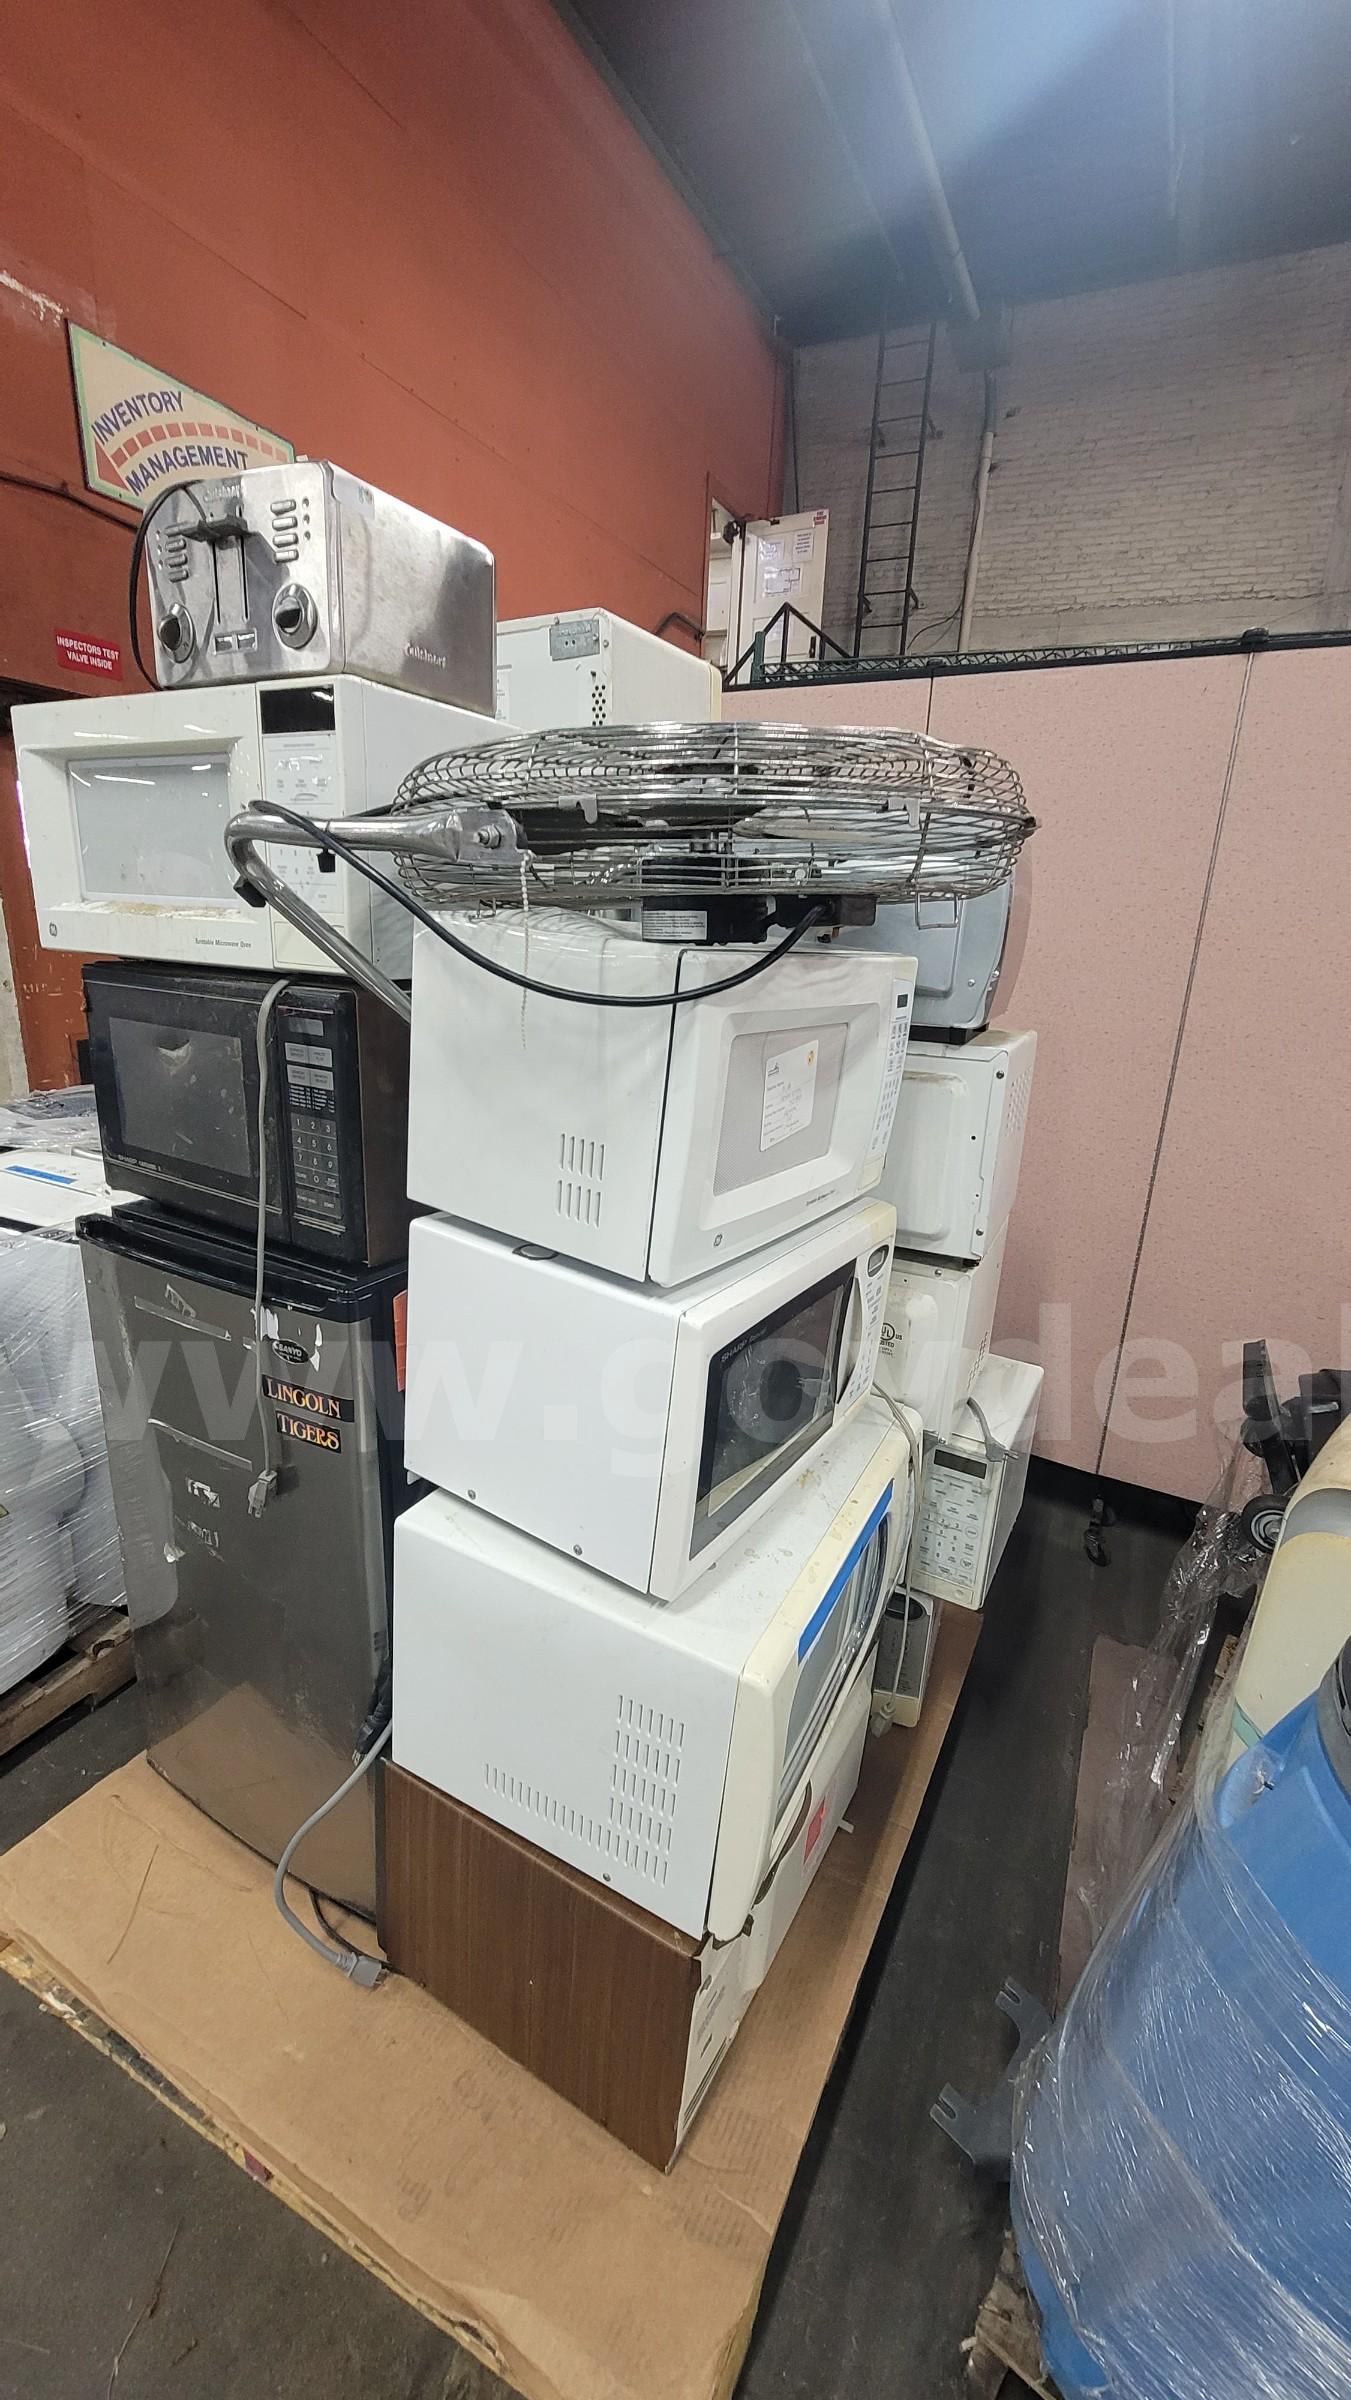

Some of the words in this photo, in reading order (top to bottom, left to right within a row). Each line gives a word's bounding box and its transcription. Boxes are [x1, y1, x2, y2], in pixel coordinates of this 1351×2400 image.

[91, 390, 185, 446] INVENTORY
[125, 445, 249, 496] MANAGEMENT
[56, 635, 101, 656] INSPECTORS
[102, 648, 119, 660] TEST
[66, 650, 89, 664] VALVE
[89, 656, 113, 670] INSIDE
[279, 1343, 302, 1358] SANYO
[277, 1413, 339, 1450] TIGERS
